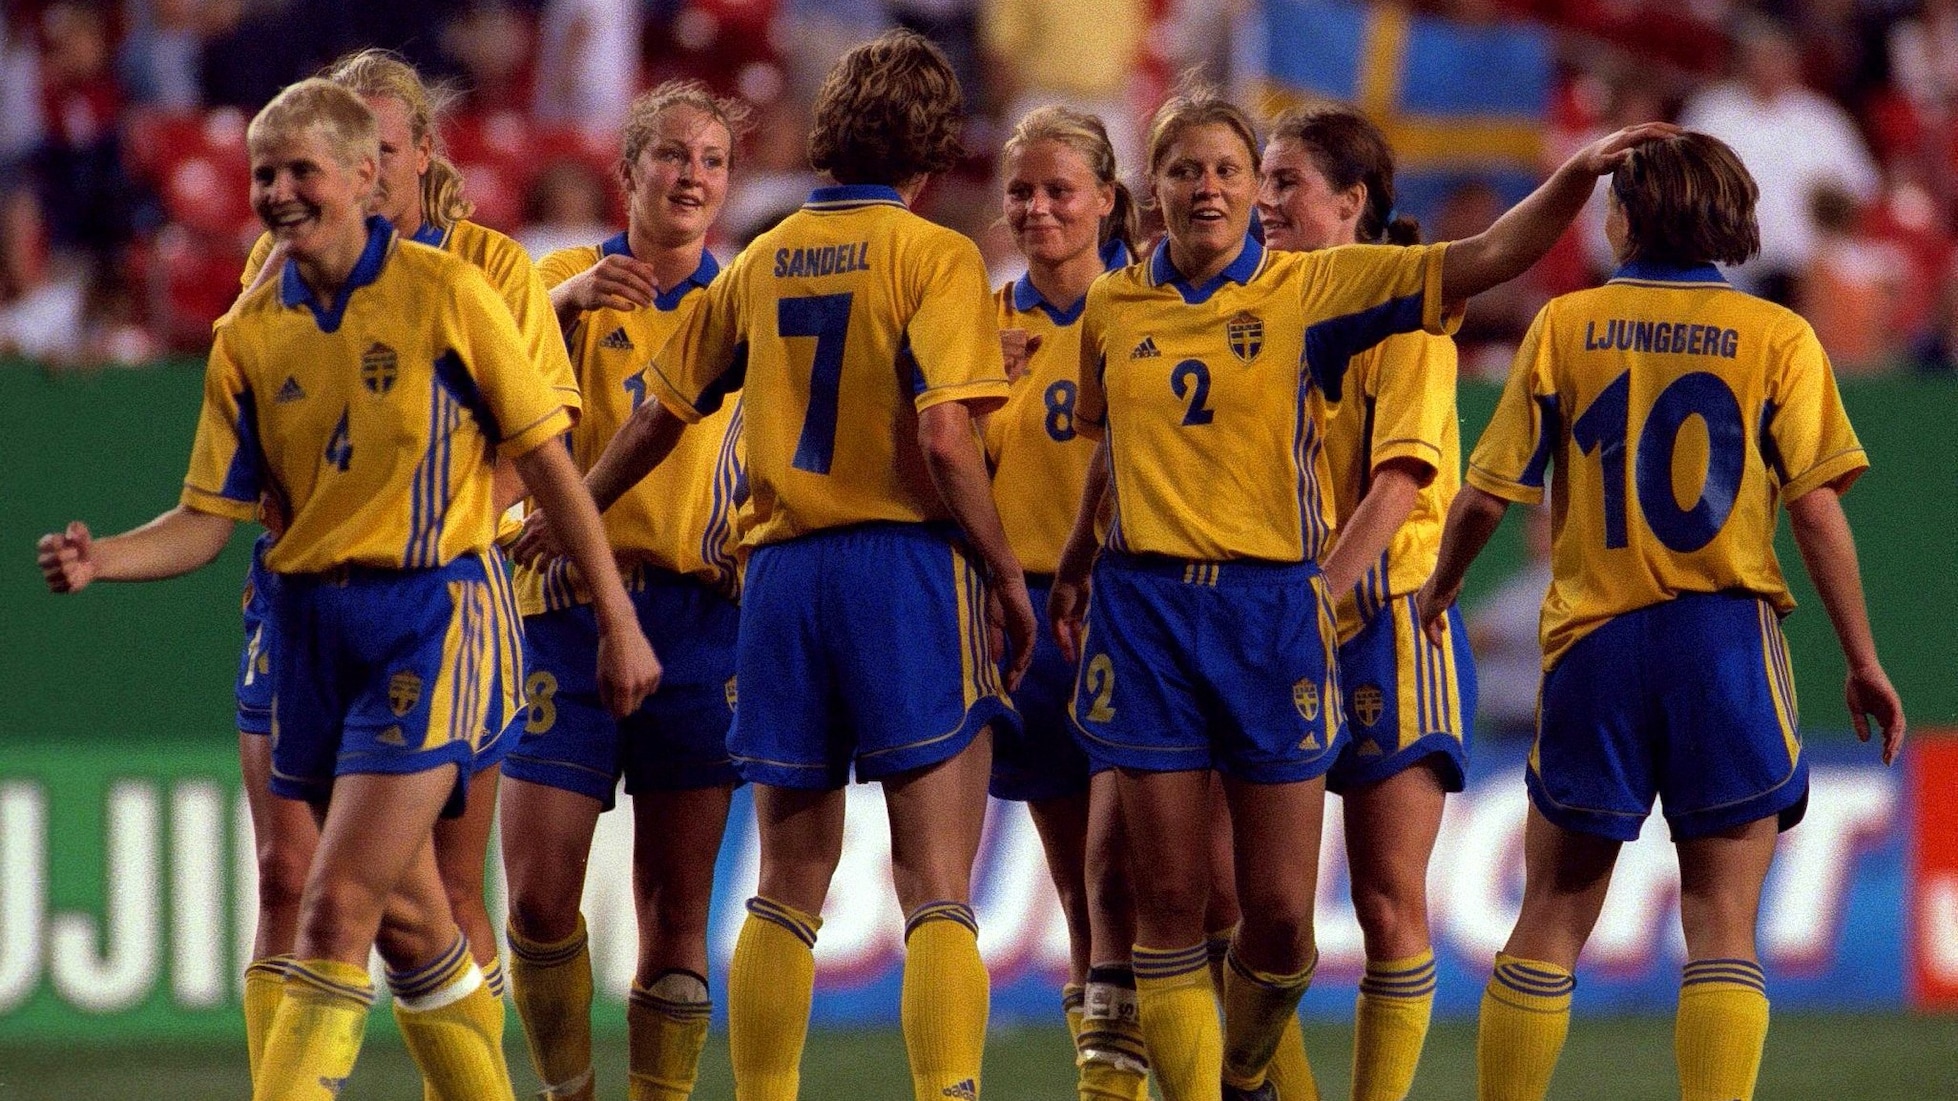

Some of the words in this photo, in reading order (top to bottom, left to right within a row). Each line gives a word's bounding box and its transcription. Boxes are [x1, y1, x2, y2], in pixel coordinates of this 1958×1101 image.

[774, 241, 870, 277] SANDELL
[1585, 319, 1739, 359] LJUNGBERG
[778, 291, 854, 475] 7
[1044, 379, 1077, 442] 8
[1171, 358, 1215, 427] 2
[325, 400, 354, 473] 4
[1572, 368, 1746, 554] 10
[524, 671, 558, 735] 8
[1085, 653, 1117, 722] 2
